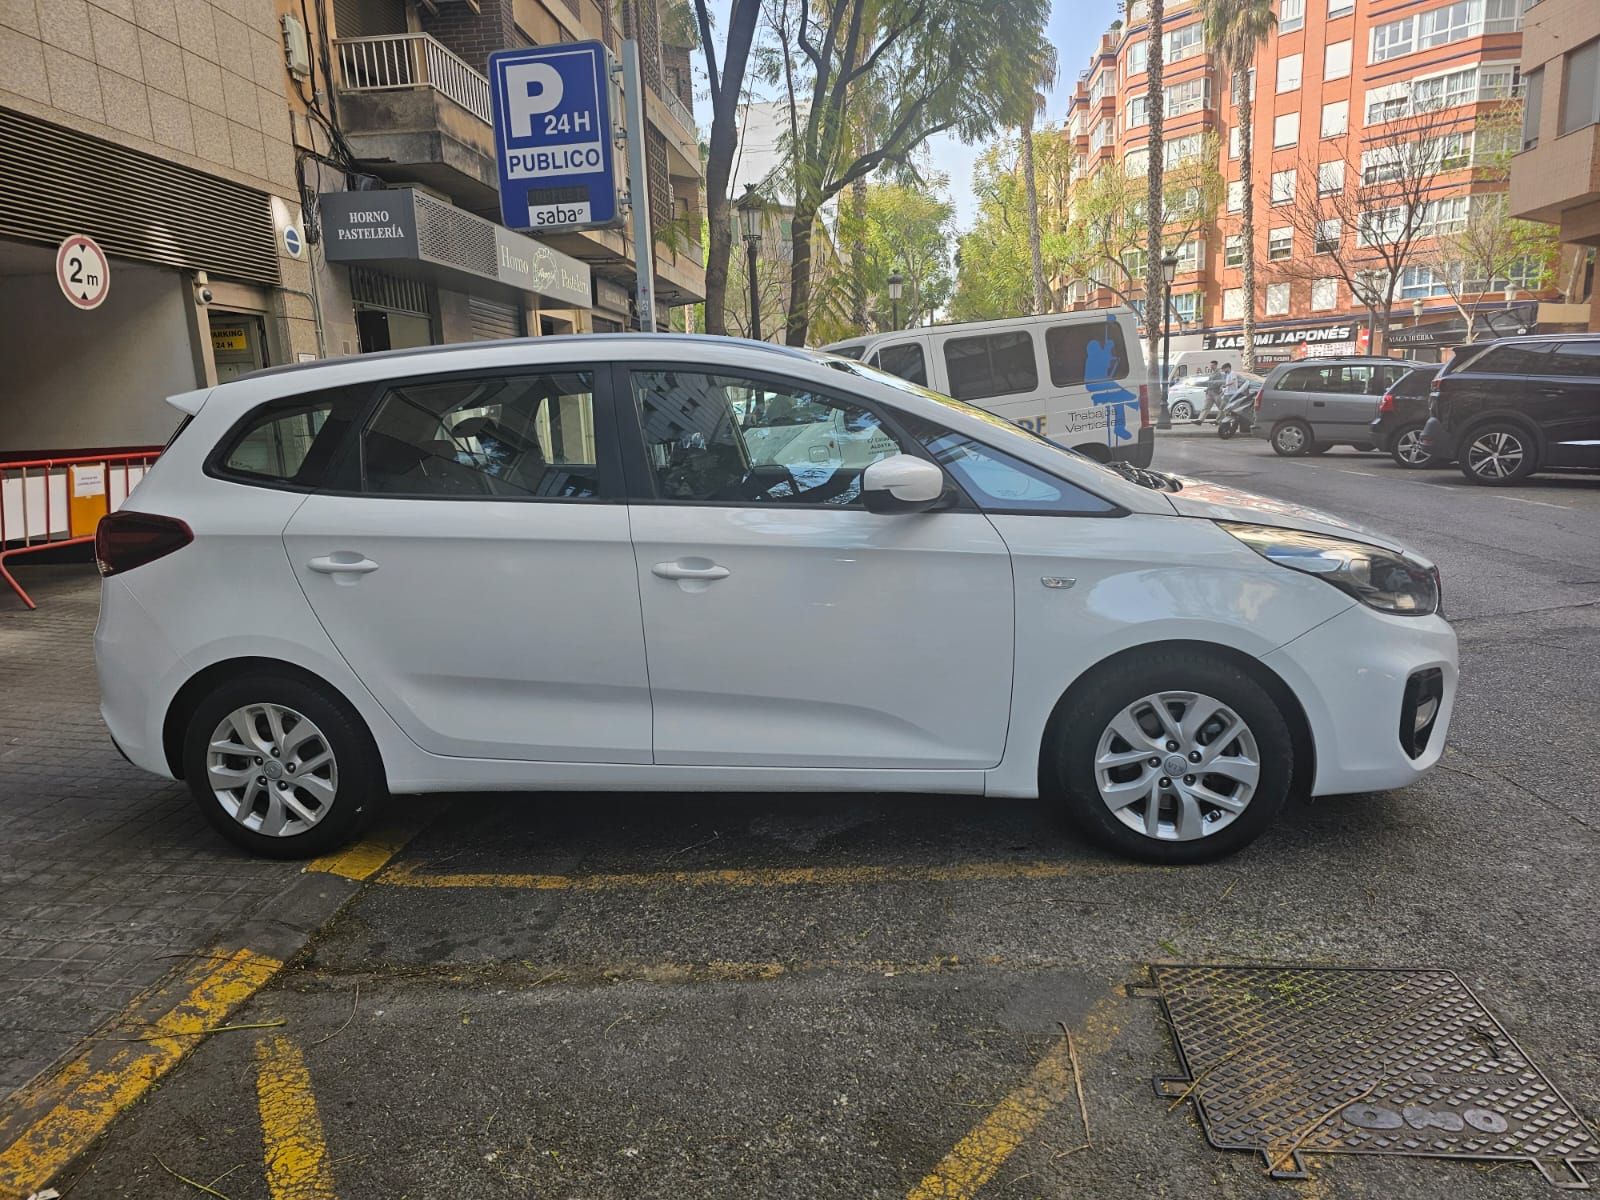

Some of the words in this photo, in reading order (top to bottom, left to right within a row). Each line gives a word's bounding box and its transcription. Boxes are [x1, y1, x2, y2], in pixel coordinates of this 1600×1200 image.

[505, 62, 564, 138] P
[508, 148, 601, 173] PUBLICO
[348, 210, 390, 223] HORNO
[337, 223, 405, 240] PASTELERÍA
[500, 244, 529, 274] Horno
[69, 257, 83, 284] 2
[86, 274, 99, 287] m
[212, 329, 243, 338] ARKING
[1274, 325, 1351, 344] JAPONÉS
